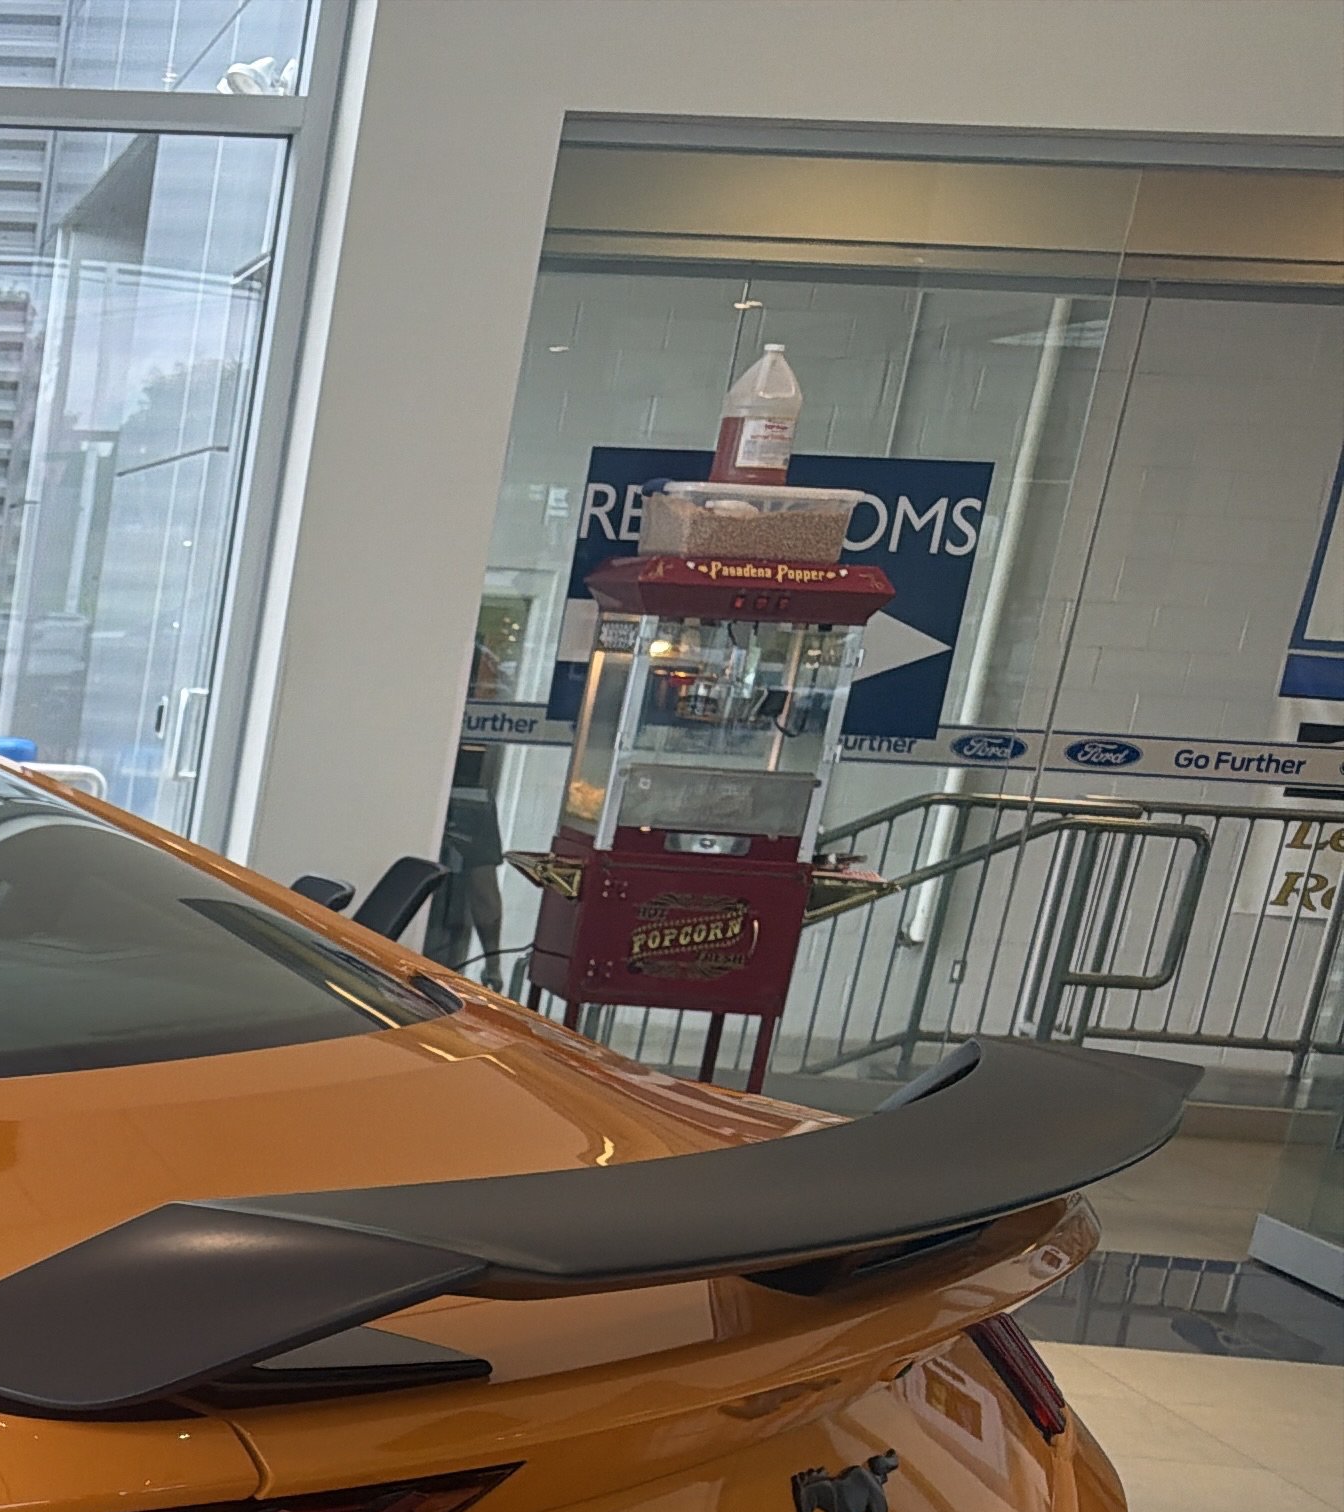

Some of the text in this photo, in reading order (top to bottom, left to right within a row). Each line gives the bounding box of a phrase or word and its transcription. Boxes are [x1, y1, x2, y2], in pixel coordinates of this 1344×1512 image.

[578, 483, 983, 556] REOMS
[709, 560, 826, 583] Pasadena Popper
[464, 711, 538, 734] urther
[838, 734, 917, 754] urther
[1173, 749, 1210, 770] Go
[1214, 751, 1307, 775] Further
[631, 917, 744, 954] POPCORN
